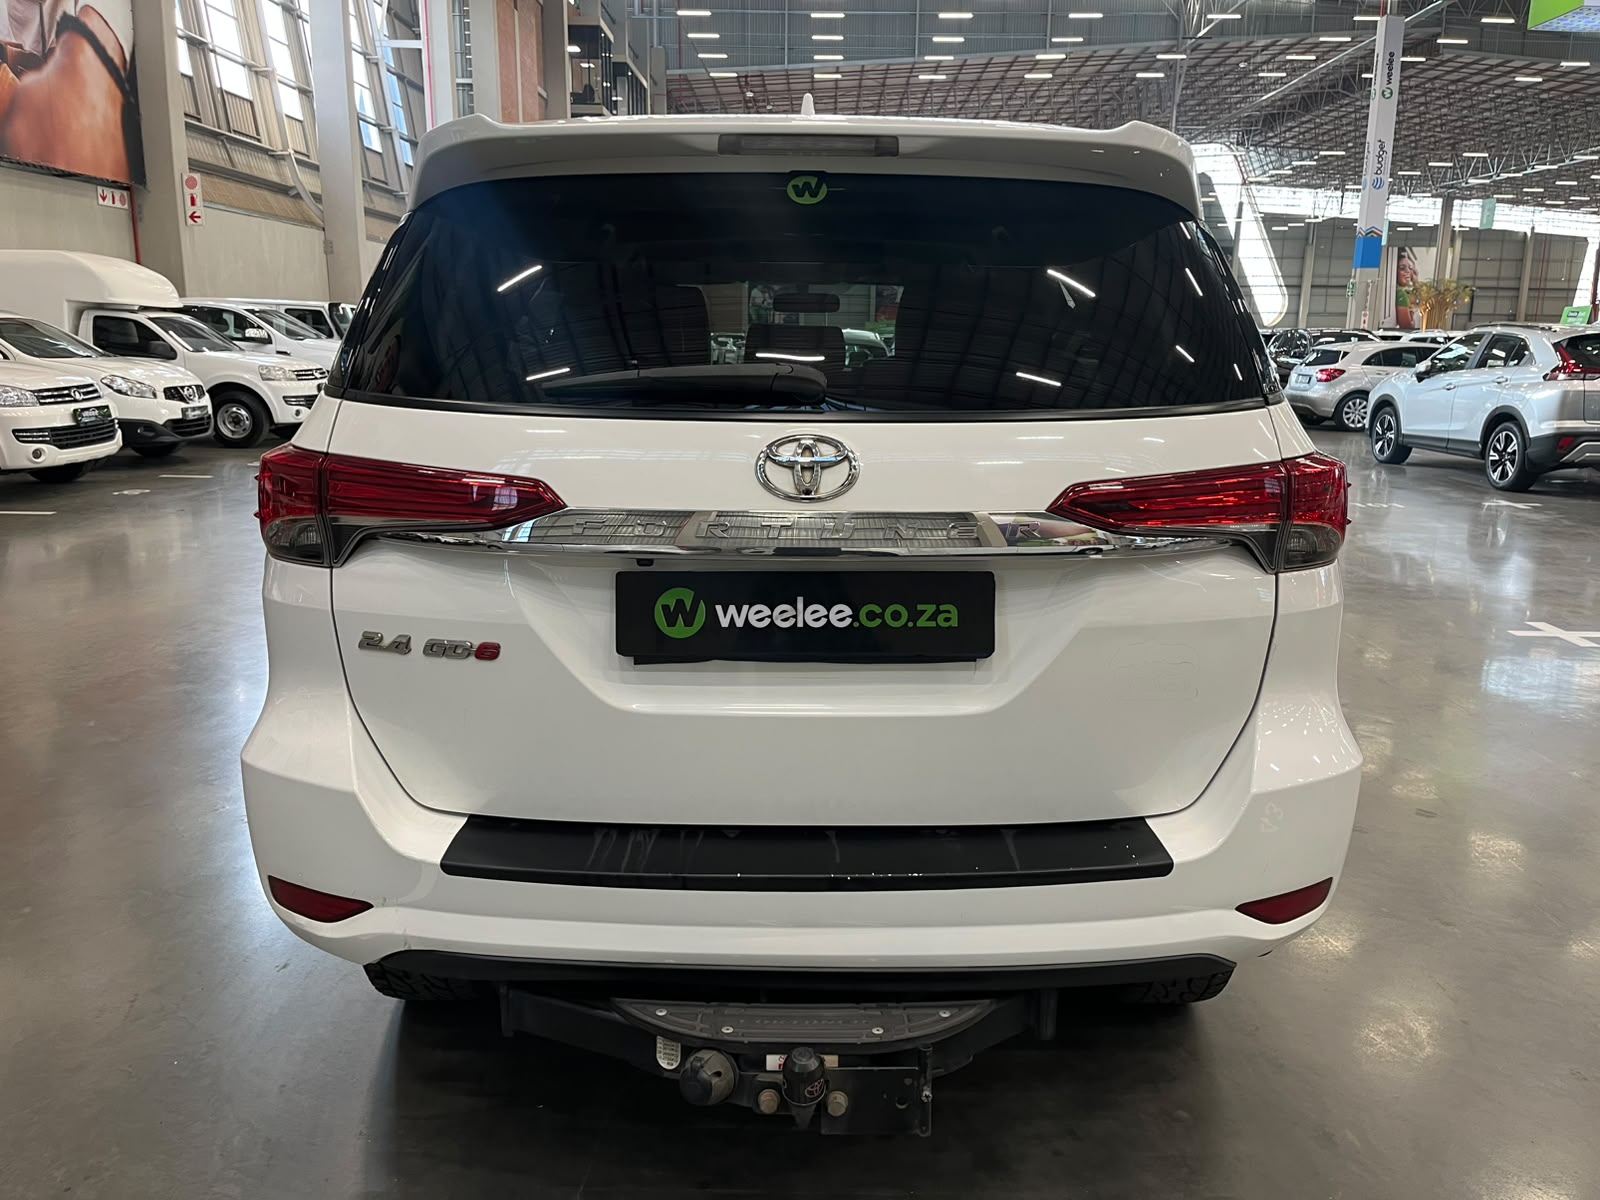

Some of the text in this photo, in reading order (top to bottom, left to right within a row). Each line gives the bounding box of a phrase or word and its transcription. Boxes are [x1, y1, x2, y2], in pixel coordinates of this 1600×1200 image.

[1386, 51, 1395, 85] weelee
[1374, 139, 1387, 175] budget
[572, 517, 1041, 540] FORTUNER
[714, 596, 959, 629] weelee.co.za
[358, 630, 412, 655] 2.4
